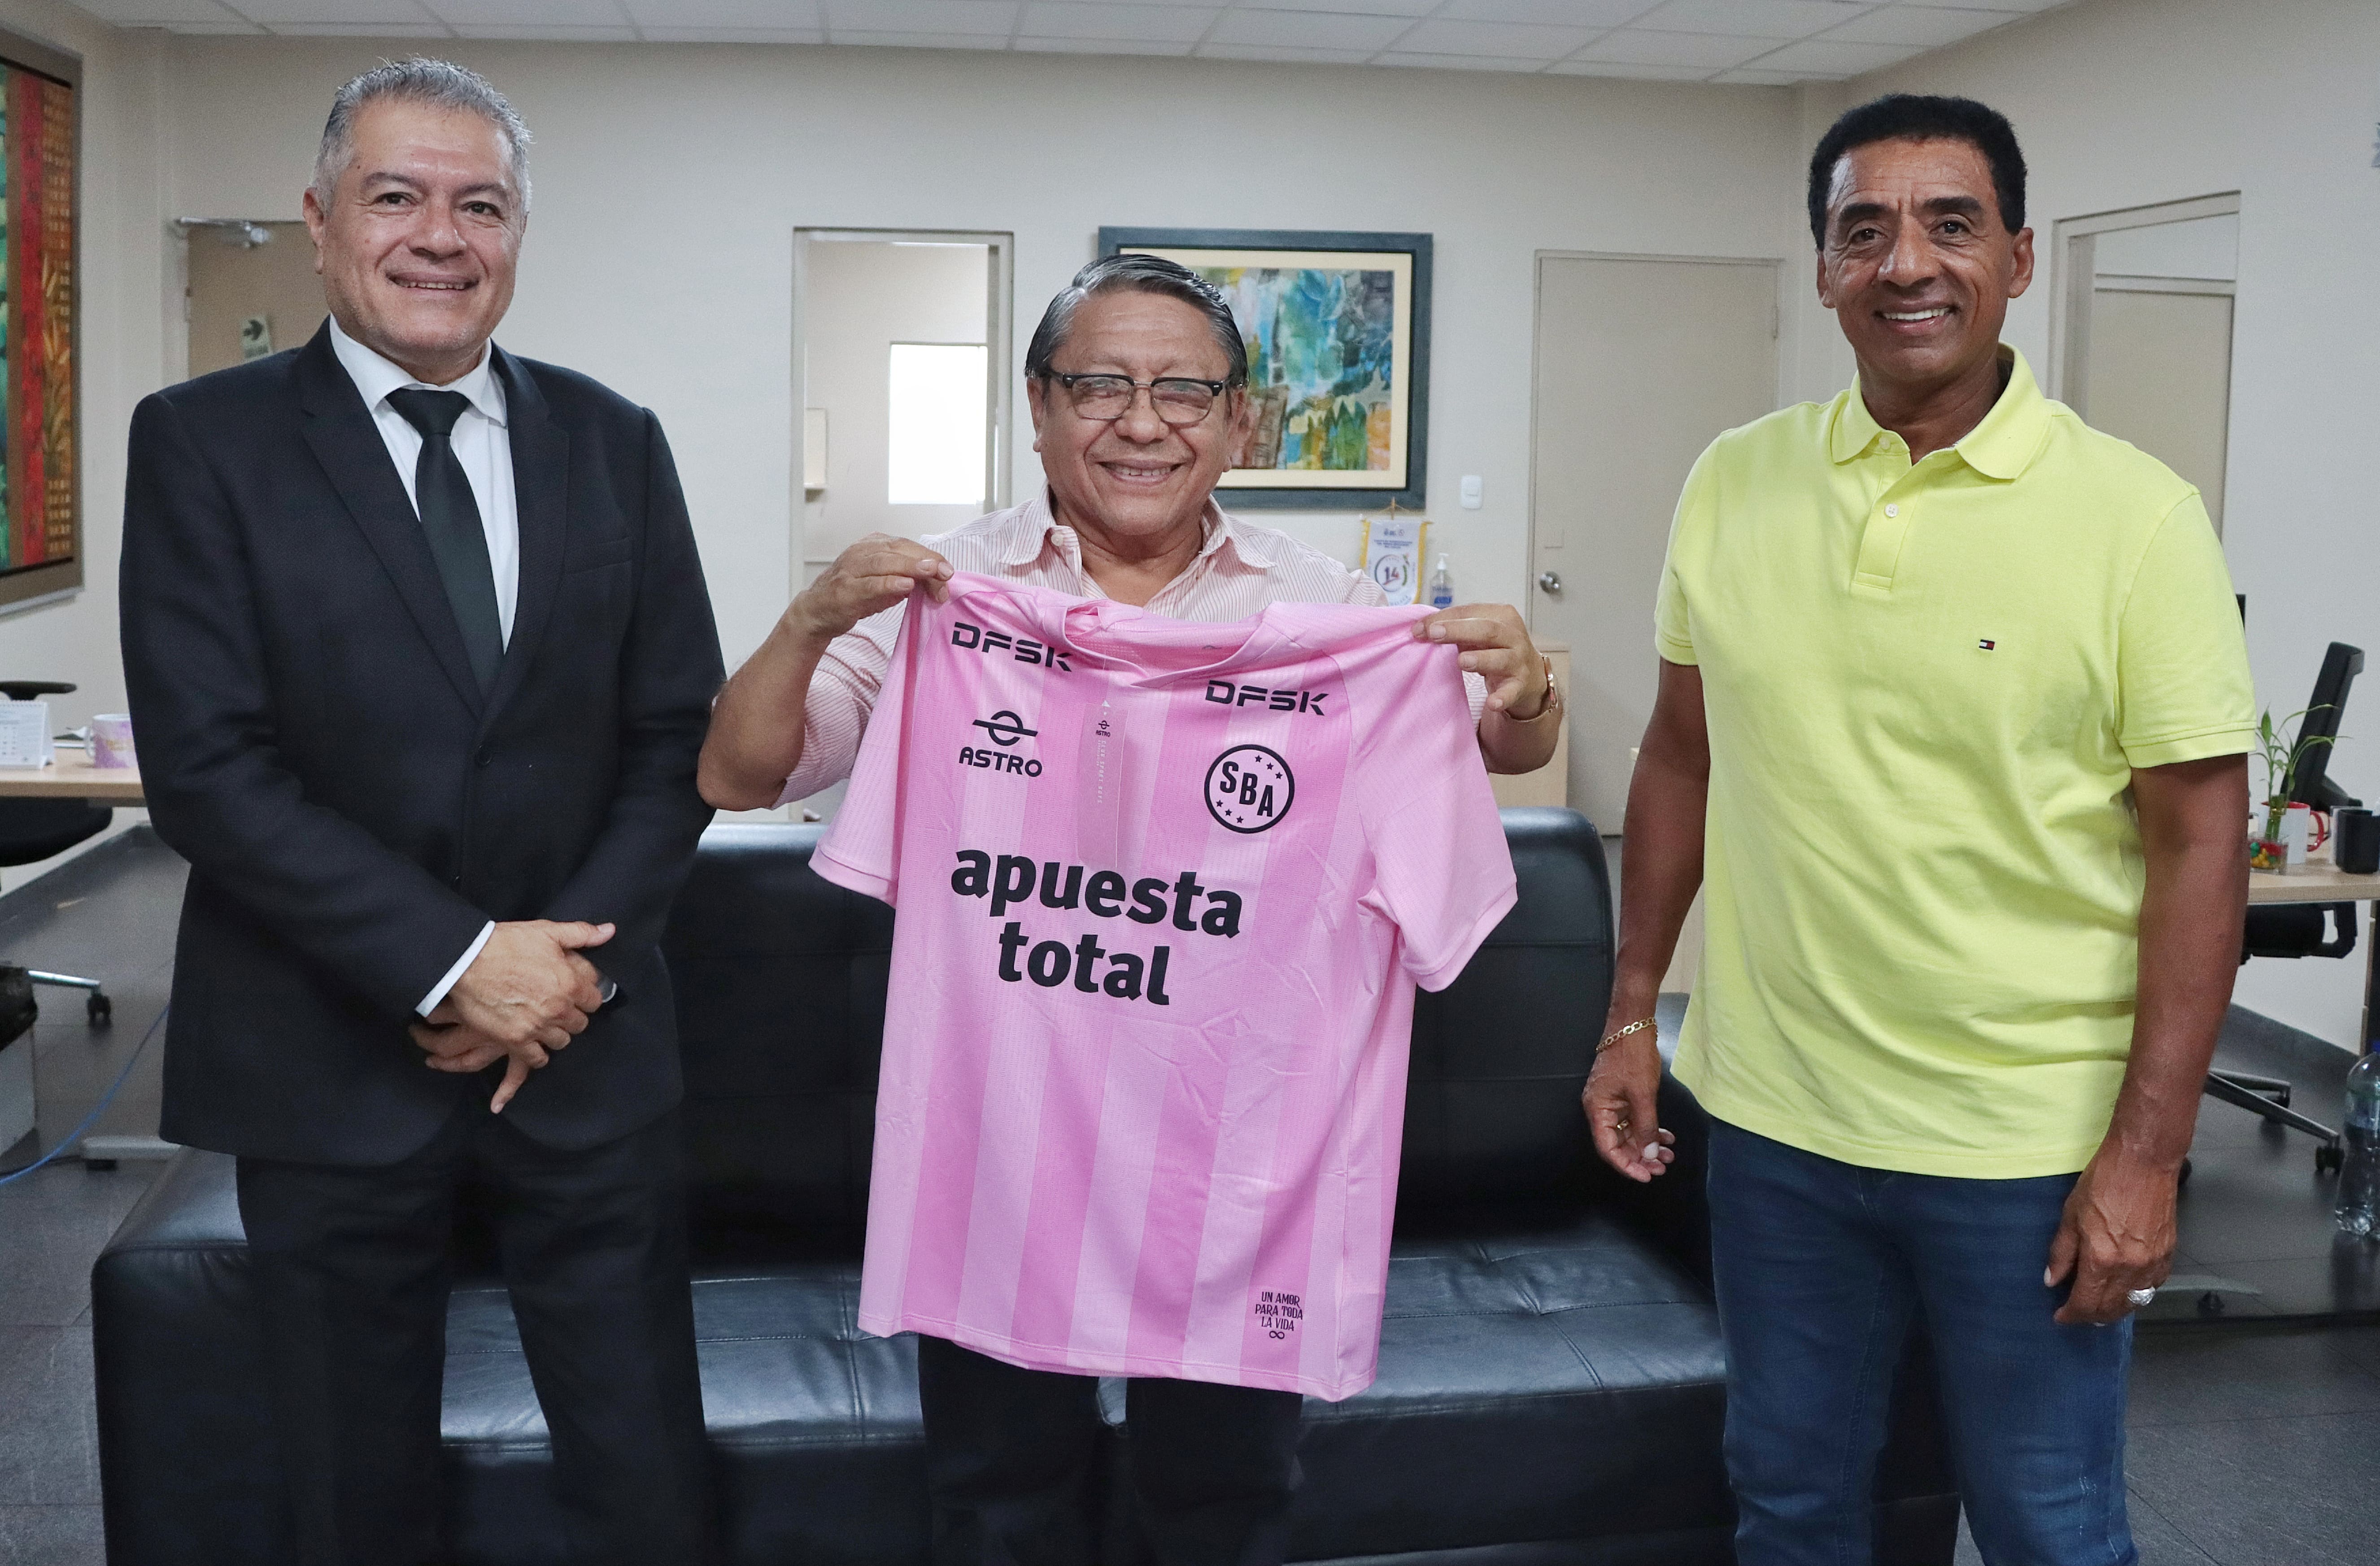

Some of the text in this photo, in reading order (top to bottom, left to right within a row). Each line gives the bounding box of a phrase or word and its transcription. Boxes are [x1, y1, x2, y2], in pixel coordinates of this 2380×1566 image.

[951, 621, 1074, 673] DFSK
[1205, 679, 1329, 716] DFSK
[958, 746, 1043, 778] ASTRO
[1220, 761, 1273, 817] SBA
[950, 849, 1242, 939] apuesta
[998, 921, 1170, 1006] total
[1255, 1304, 1303, 1320] PARA TODA
[1261, 1291, 1300, 1309] UN AMOR
[1261, 1316, 1295, 1331] LA VIDA
